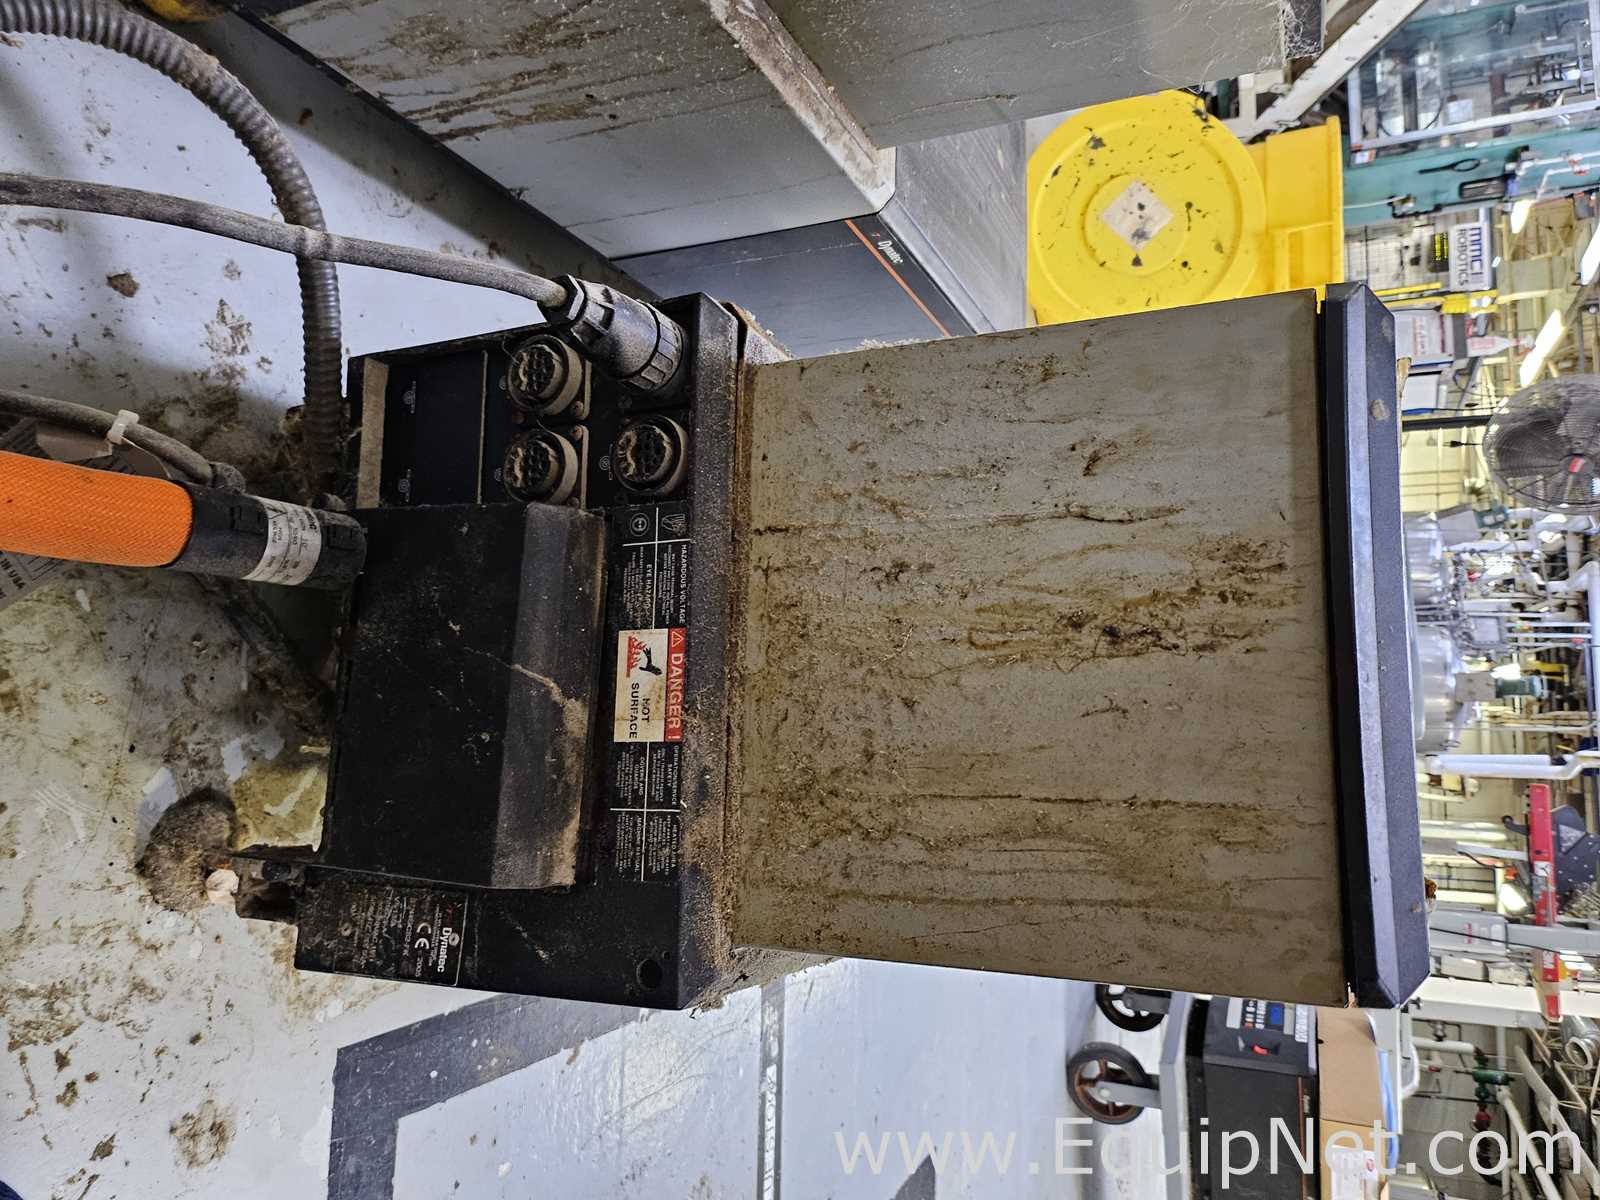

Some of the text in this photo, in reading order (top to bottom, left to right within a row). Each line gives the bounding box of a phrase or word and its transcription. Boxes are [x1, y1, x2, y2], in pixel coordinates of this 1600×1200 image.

[877, 240, 903, 264] Dynatec
[1456, 228, 1469, 287] ROBOTICS
[629, 682, 640, 739] SURFACE
[641, 698, 650, 723] HOT
[668, 653, 683, 729] DANGER
[415, 957, 424, 977] 2005
[437, 927, 452, 973] Dynatec
